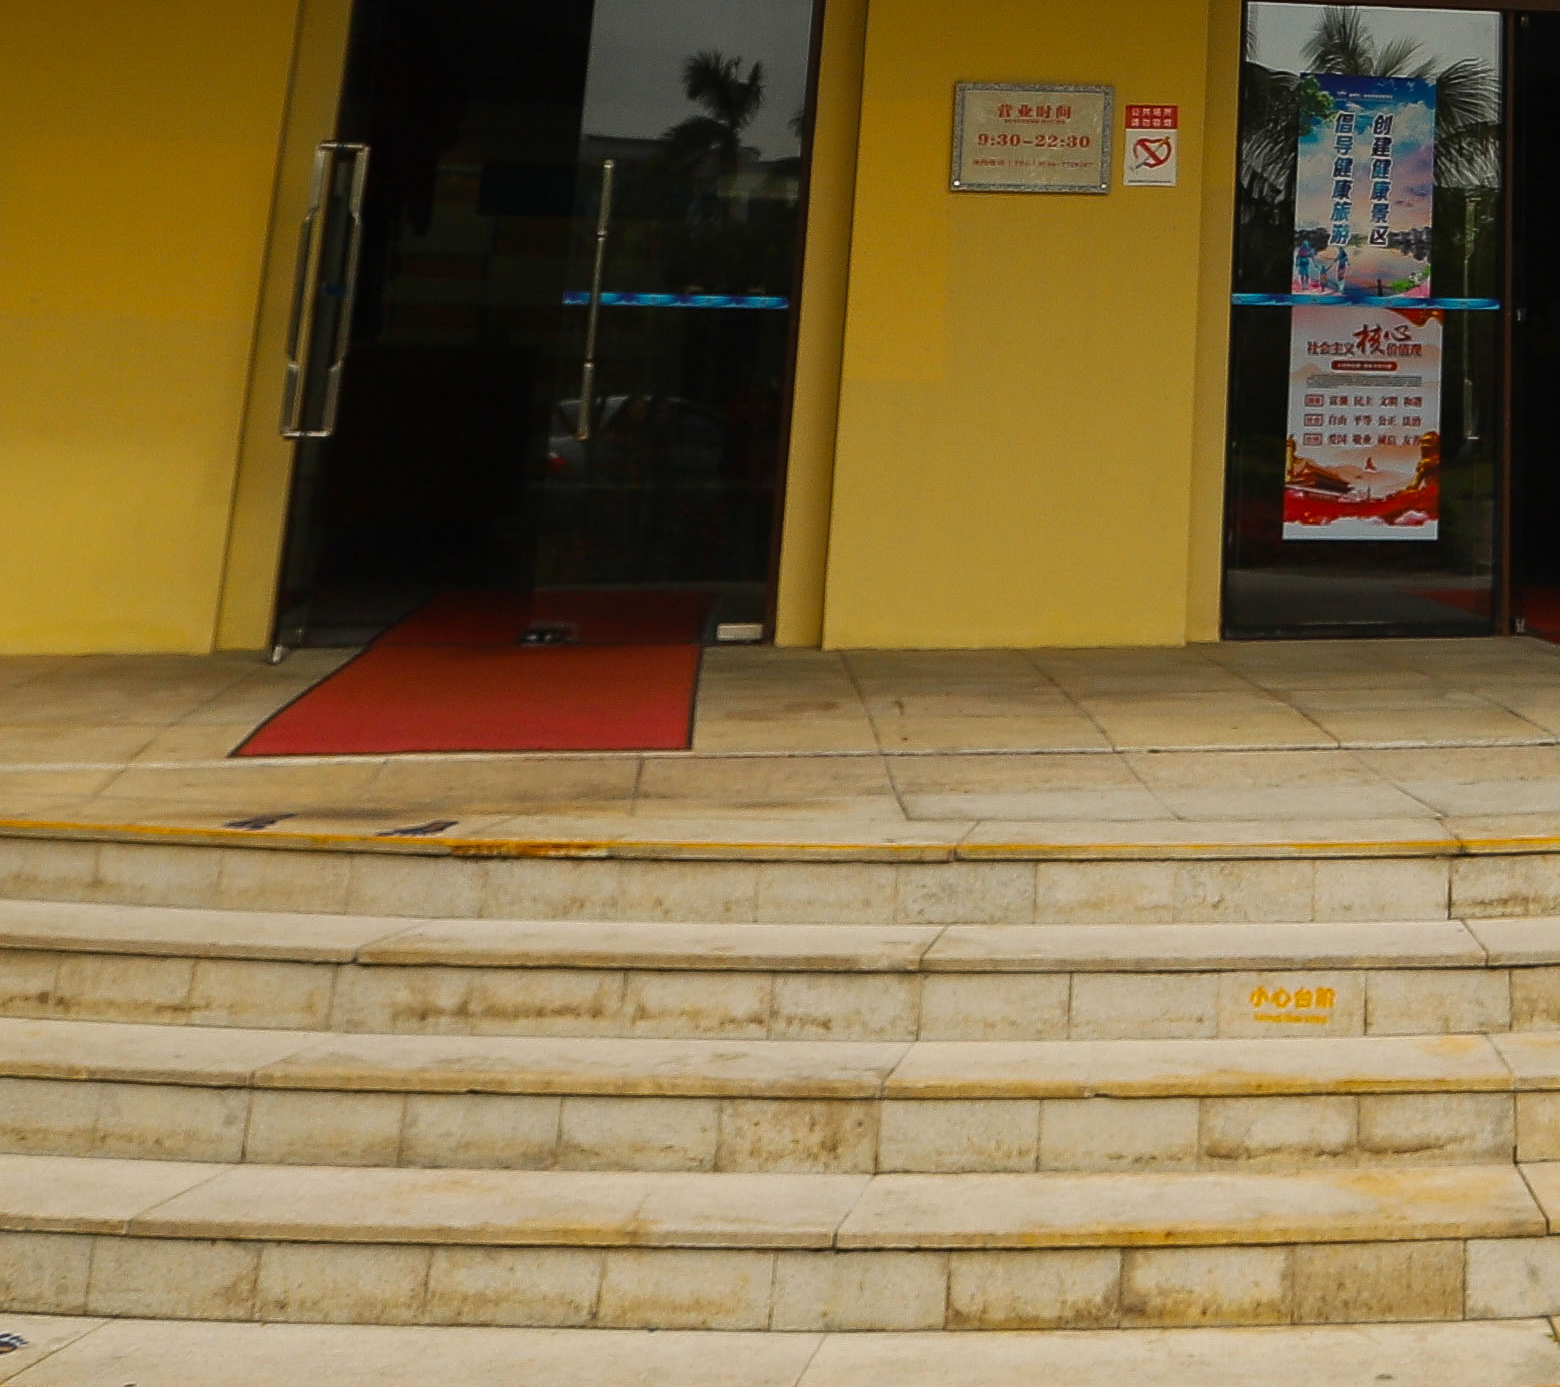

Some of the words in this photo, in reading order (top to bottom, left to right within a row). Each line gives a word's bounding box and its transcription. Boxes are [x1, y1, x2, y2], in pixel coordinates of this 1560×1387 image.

[996, 103, 1073, 120] 营业时间
[1329, 111, 1355, 246] 倡导健康旅游
[1368, 113, 1393, 246] 创建健康景区
